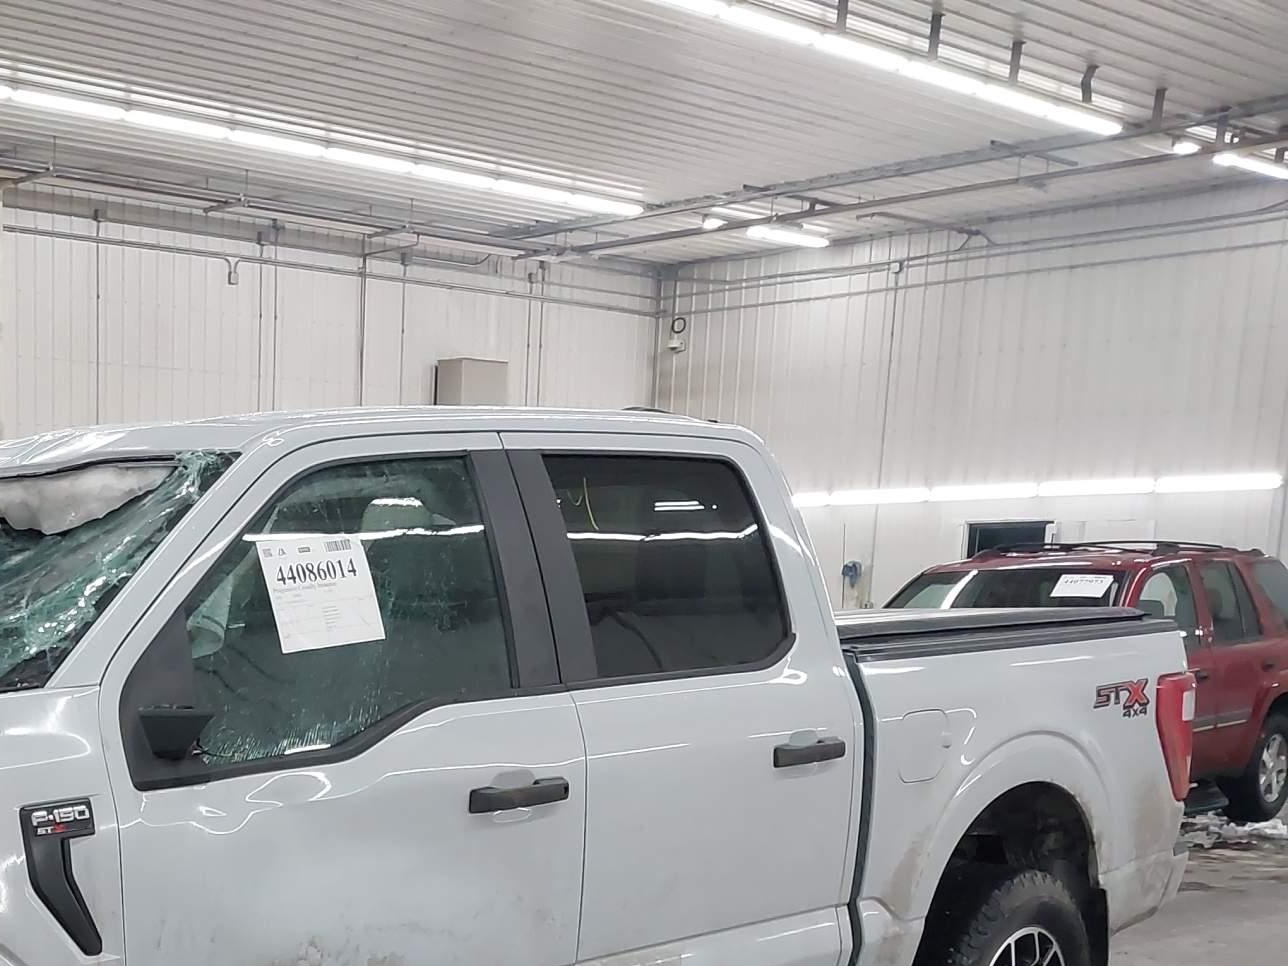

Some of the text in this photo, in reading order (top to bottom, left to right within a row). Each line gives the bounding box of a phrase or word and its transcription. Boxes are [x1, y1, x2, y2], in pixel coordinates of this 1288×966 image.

[276, 557, 357, 585] 44086014
[1093, 677, 1150, 709] STX
[31, 804, 90, 827] F-150
